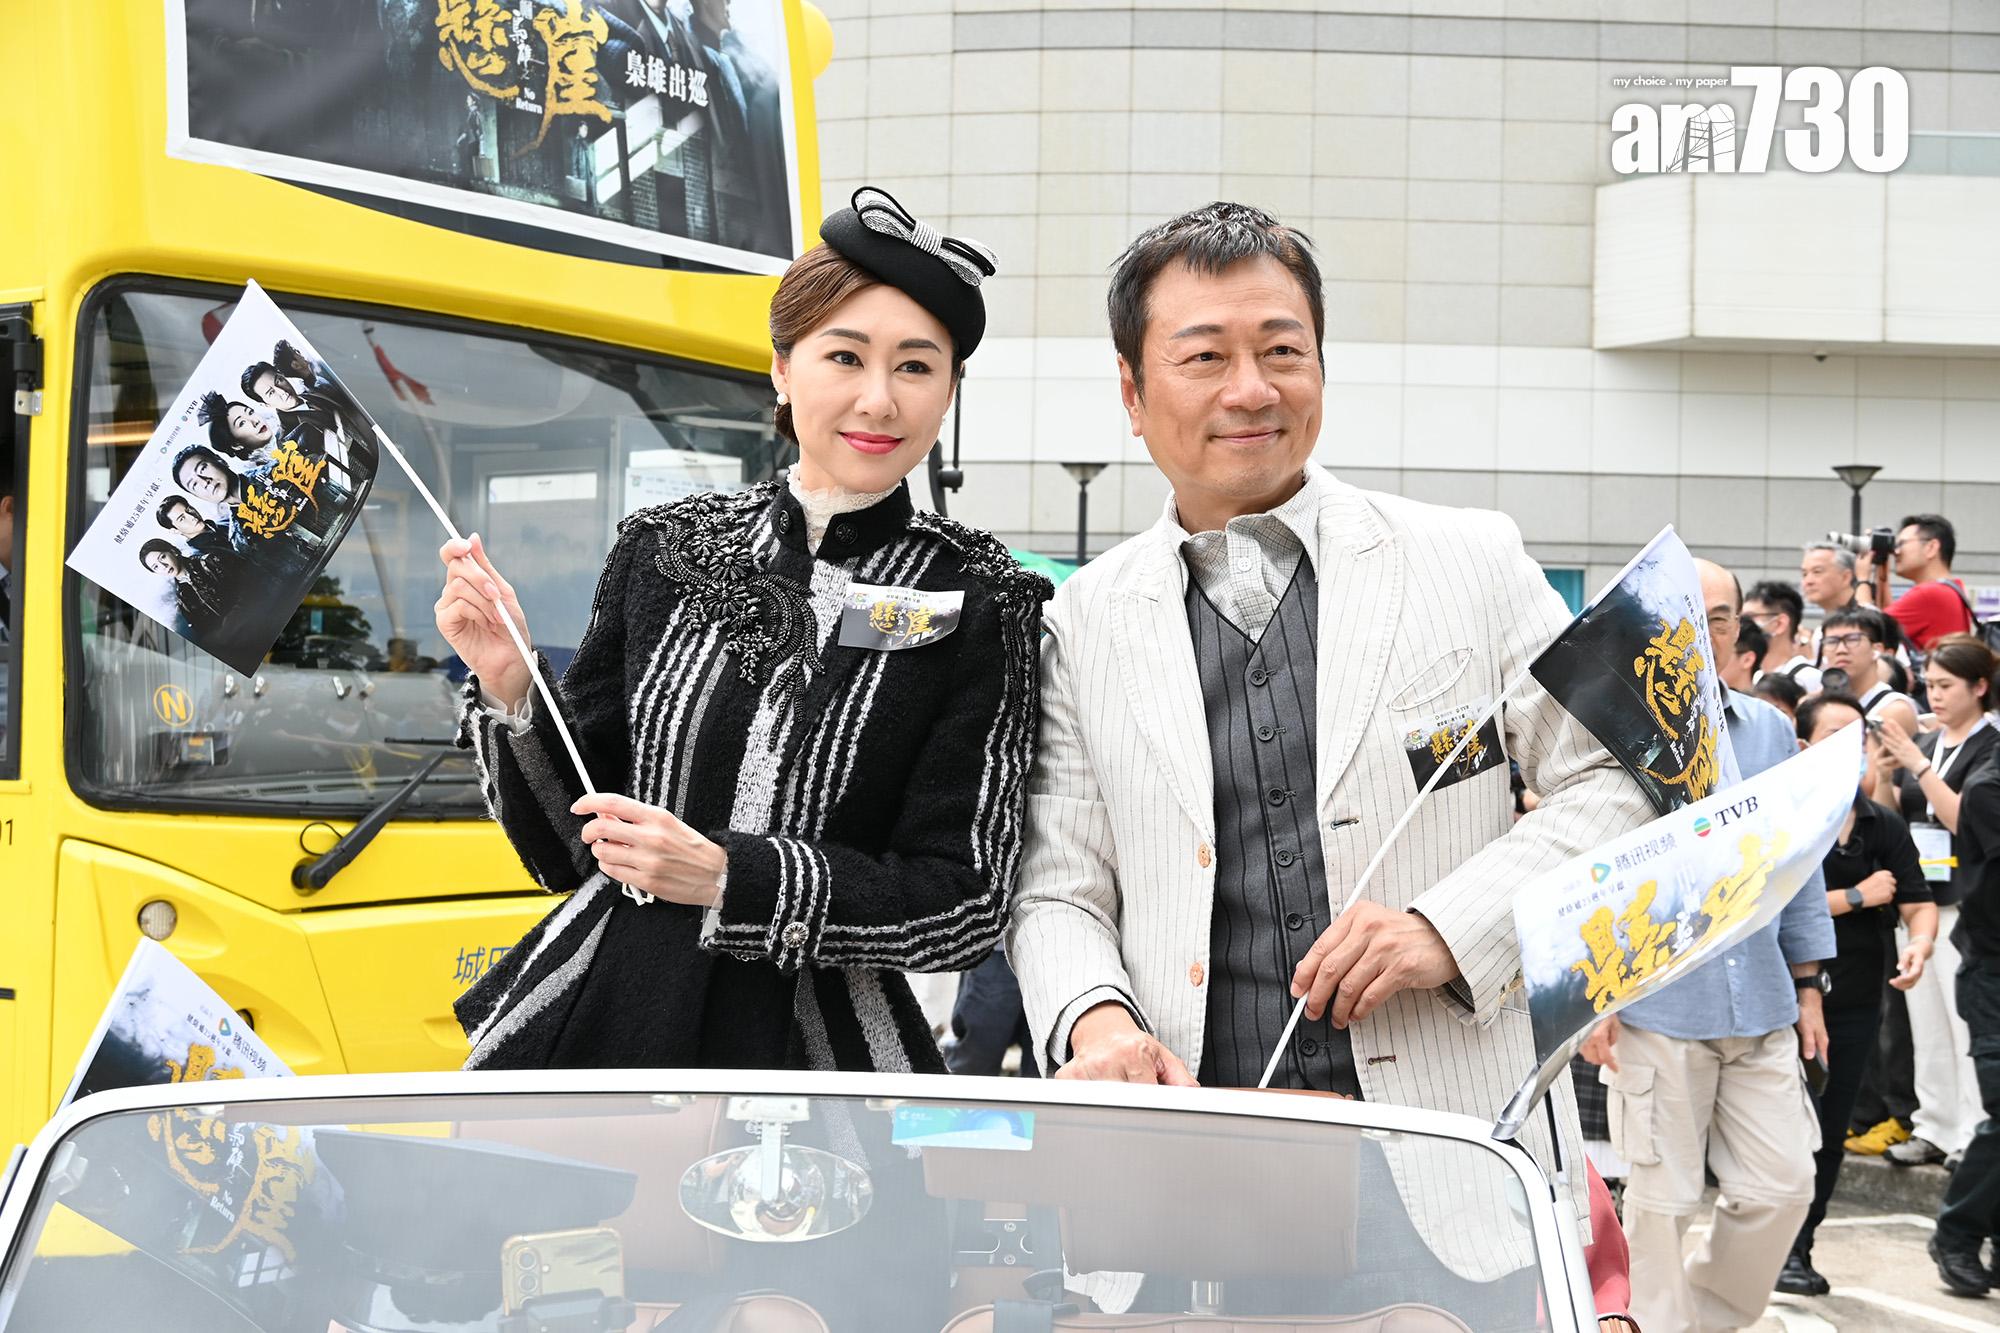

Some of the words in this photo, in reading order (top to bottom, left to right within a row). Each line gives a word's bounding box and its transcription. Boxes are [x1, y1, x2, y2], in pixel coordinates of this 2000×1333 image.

[625, 50, 709, 107] 梟雄出巡
[515, 98, 543, 115] Return
[523, 87, 536, 100] No
[161, 690, 187, 721] N
[1715, 701, 1725, 733] TVB
[1669, 741, 1684, 771] Return
[1677, 742, 1686, 758] No
[1715, 796, 1759, 827] TVB
[209, 1195, 236, 1223] Return
[222, 1190, 233, 1206] No
